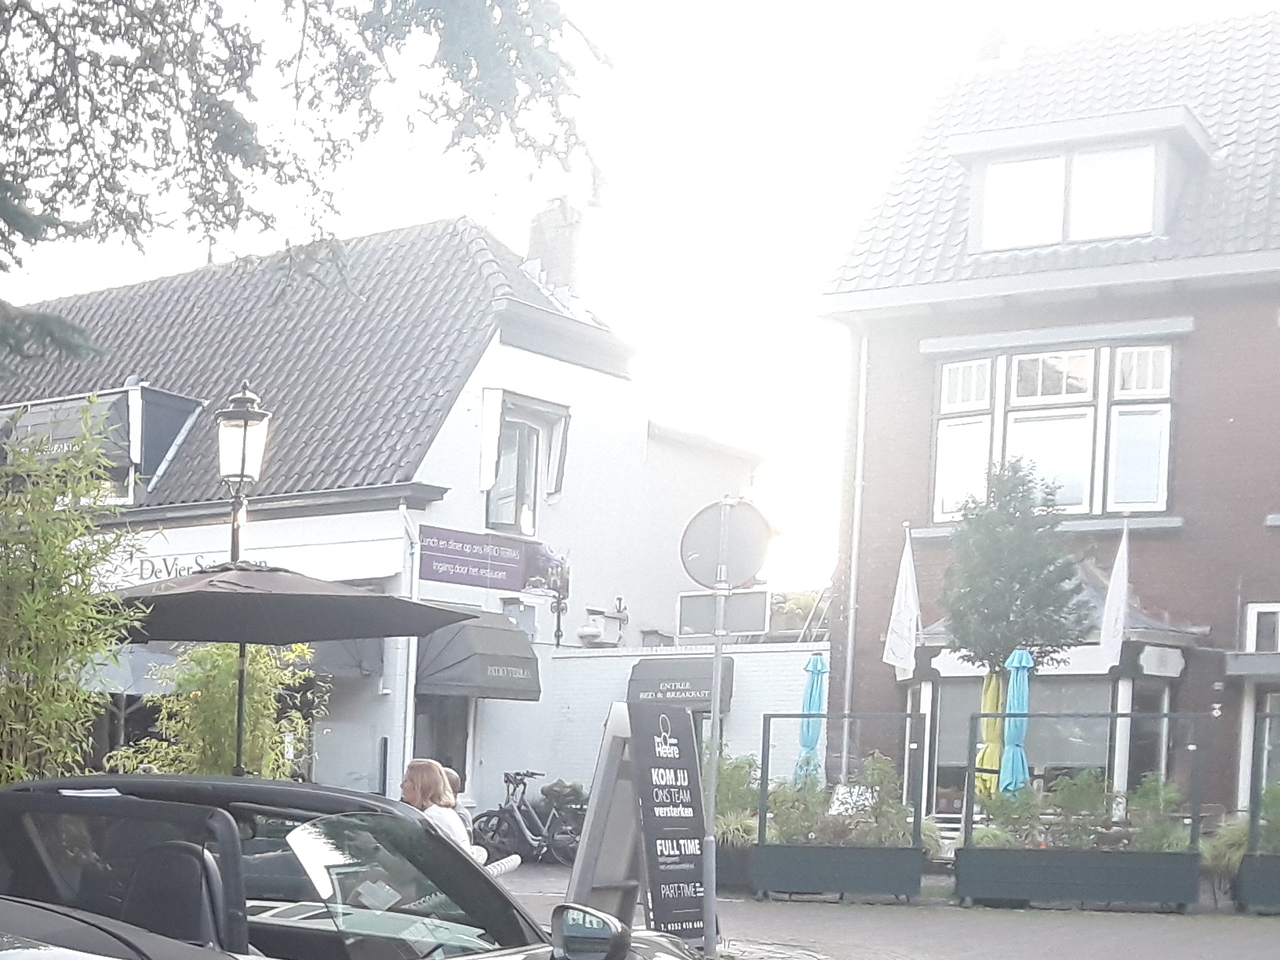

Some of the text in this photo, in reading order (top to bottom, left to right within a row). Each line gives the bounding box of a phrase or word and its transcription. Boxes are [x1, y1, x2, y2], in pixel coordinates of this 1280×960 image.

[439, 540, 447, 548] en
[139, 558, 162, 580] De
[162, 557, 193, 578] Vier
[433, 560, 454, 575] Ingang
[659, 681, 692, 690] ENTREE
[639, 690, 710, 699] BED & BREAKFAST
[651, 767, 676, 786] KOM
[653, 787, 691, 803] ONS TEAM
[653, 803, 694, 818] versterken
[656, 838, 702, 856] FULL TIME
[660, 882, 696, 899] PART-TIME
